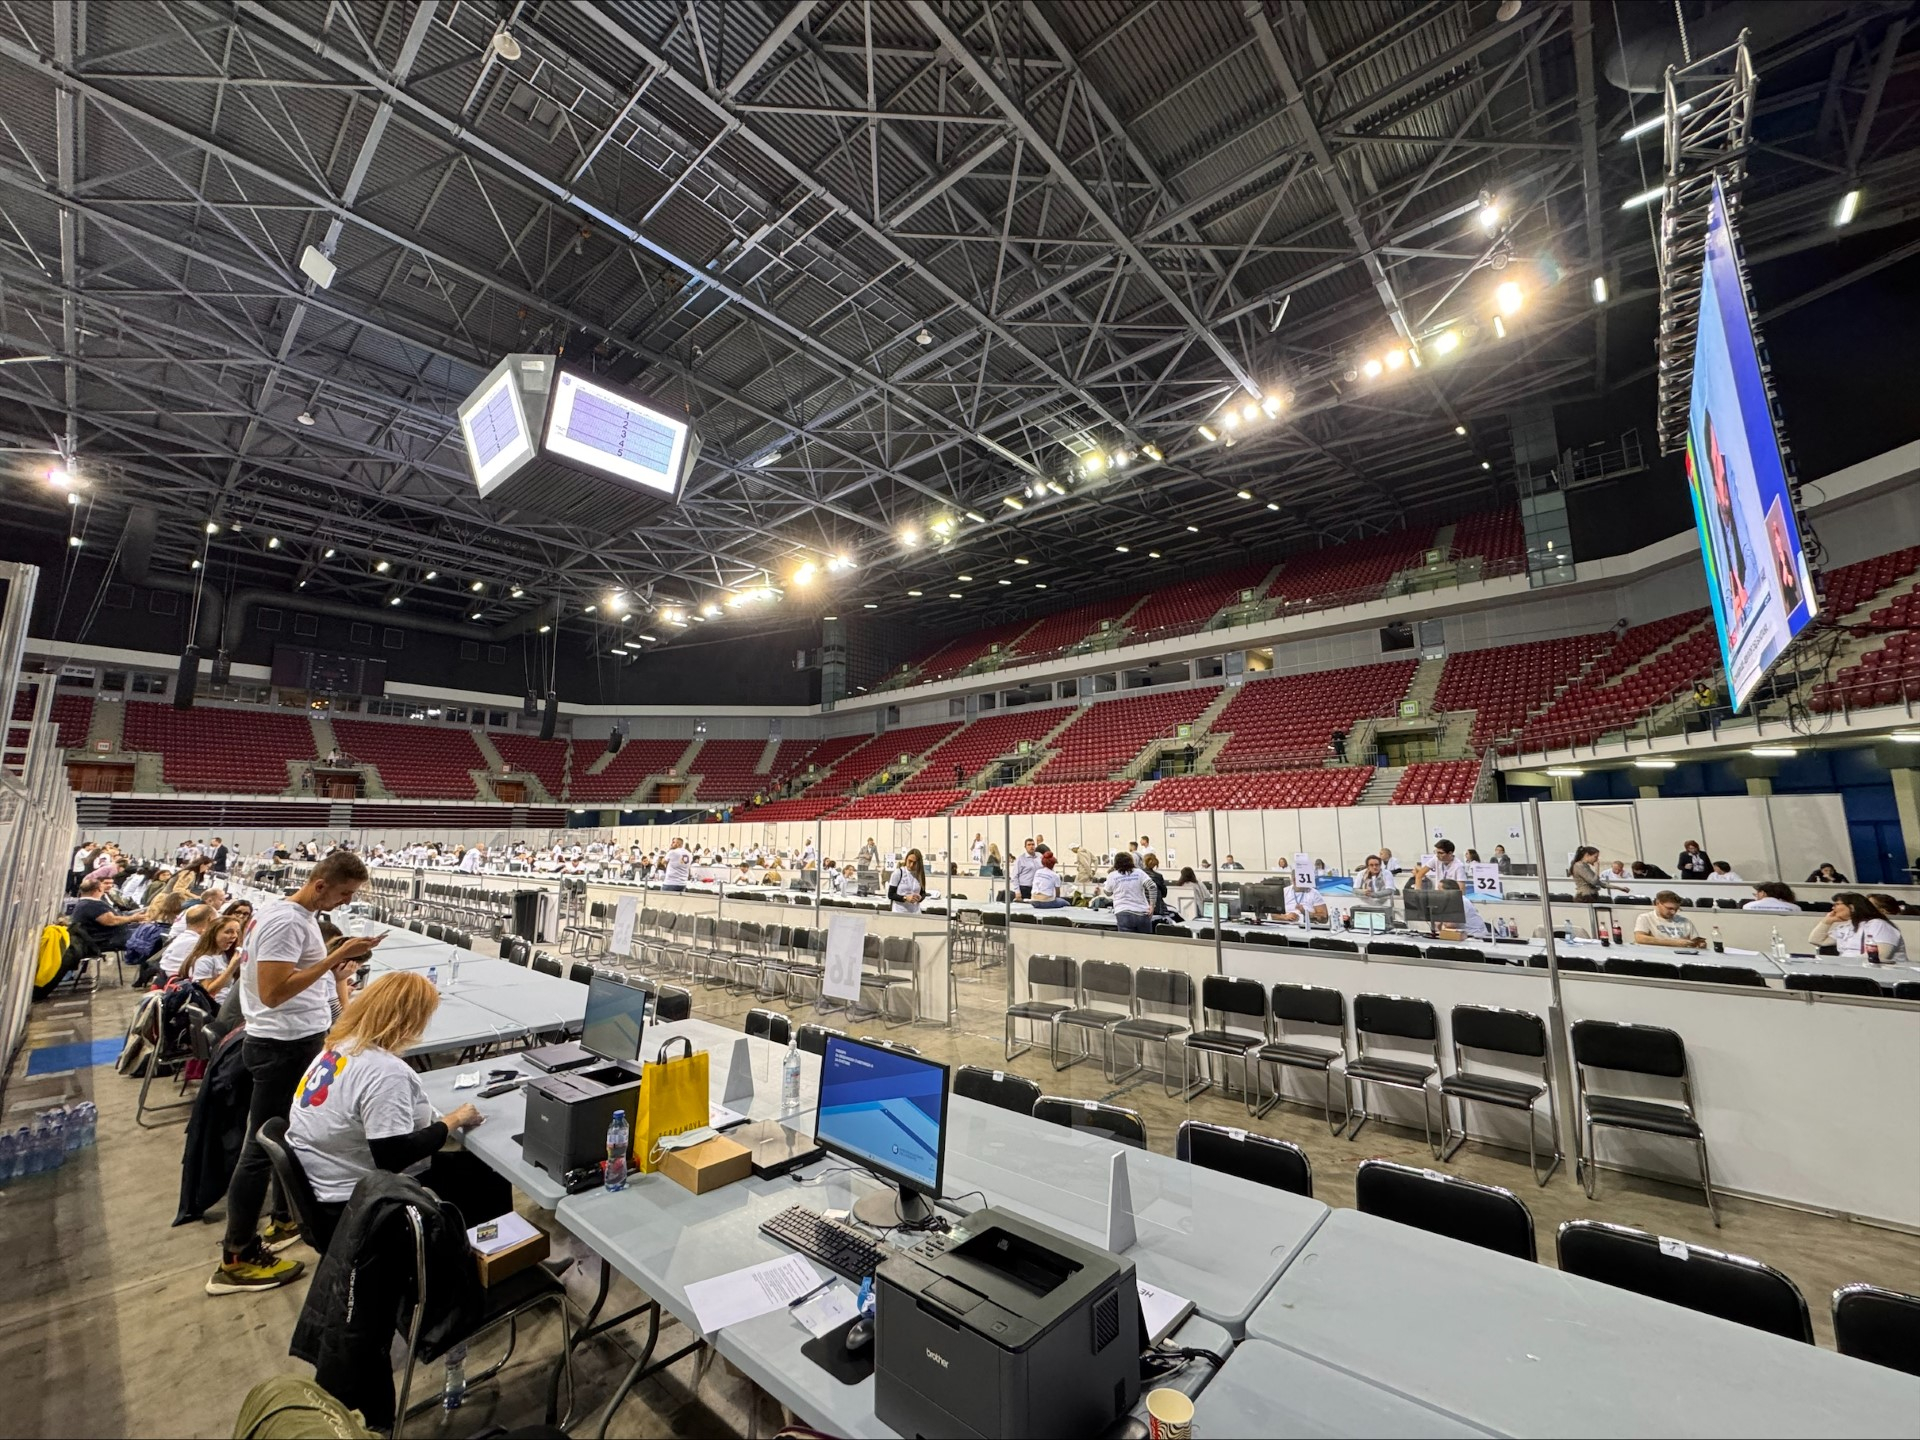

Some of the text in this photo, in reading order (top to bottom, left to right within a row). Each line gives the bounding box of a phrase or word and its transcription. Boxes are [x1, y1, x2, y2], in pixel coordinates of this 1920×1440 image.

[625, 411, 630, 420] 1
[622, 421, 629, 430] 2
[620, 430, 627, 439] 3
[618, 440, 625, 448] 4
[616, 449, 623, 457] 5
[1298, 873, 1312, 884] 31
[1477, 878, 1496, 890] 32
[925, 1347, 949, 1369] brother
